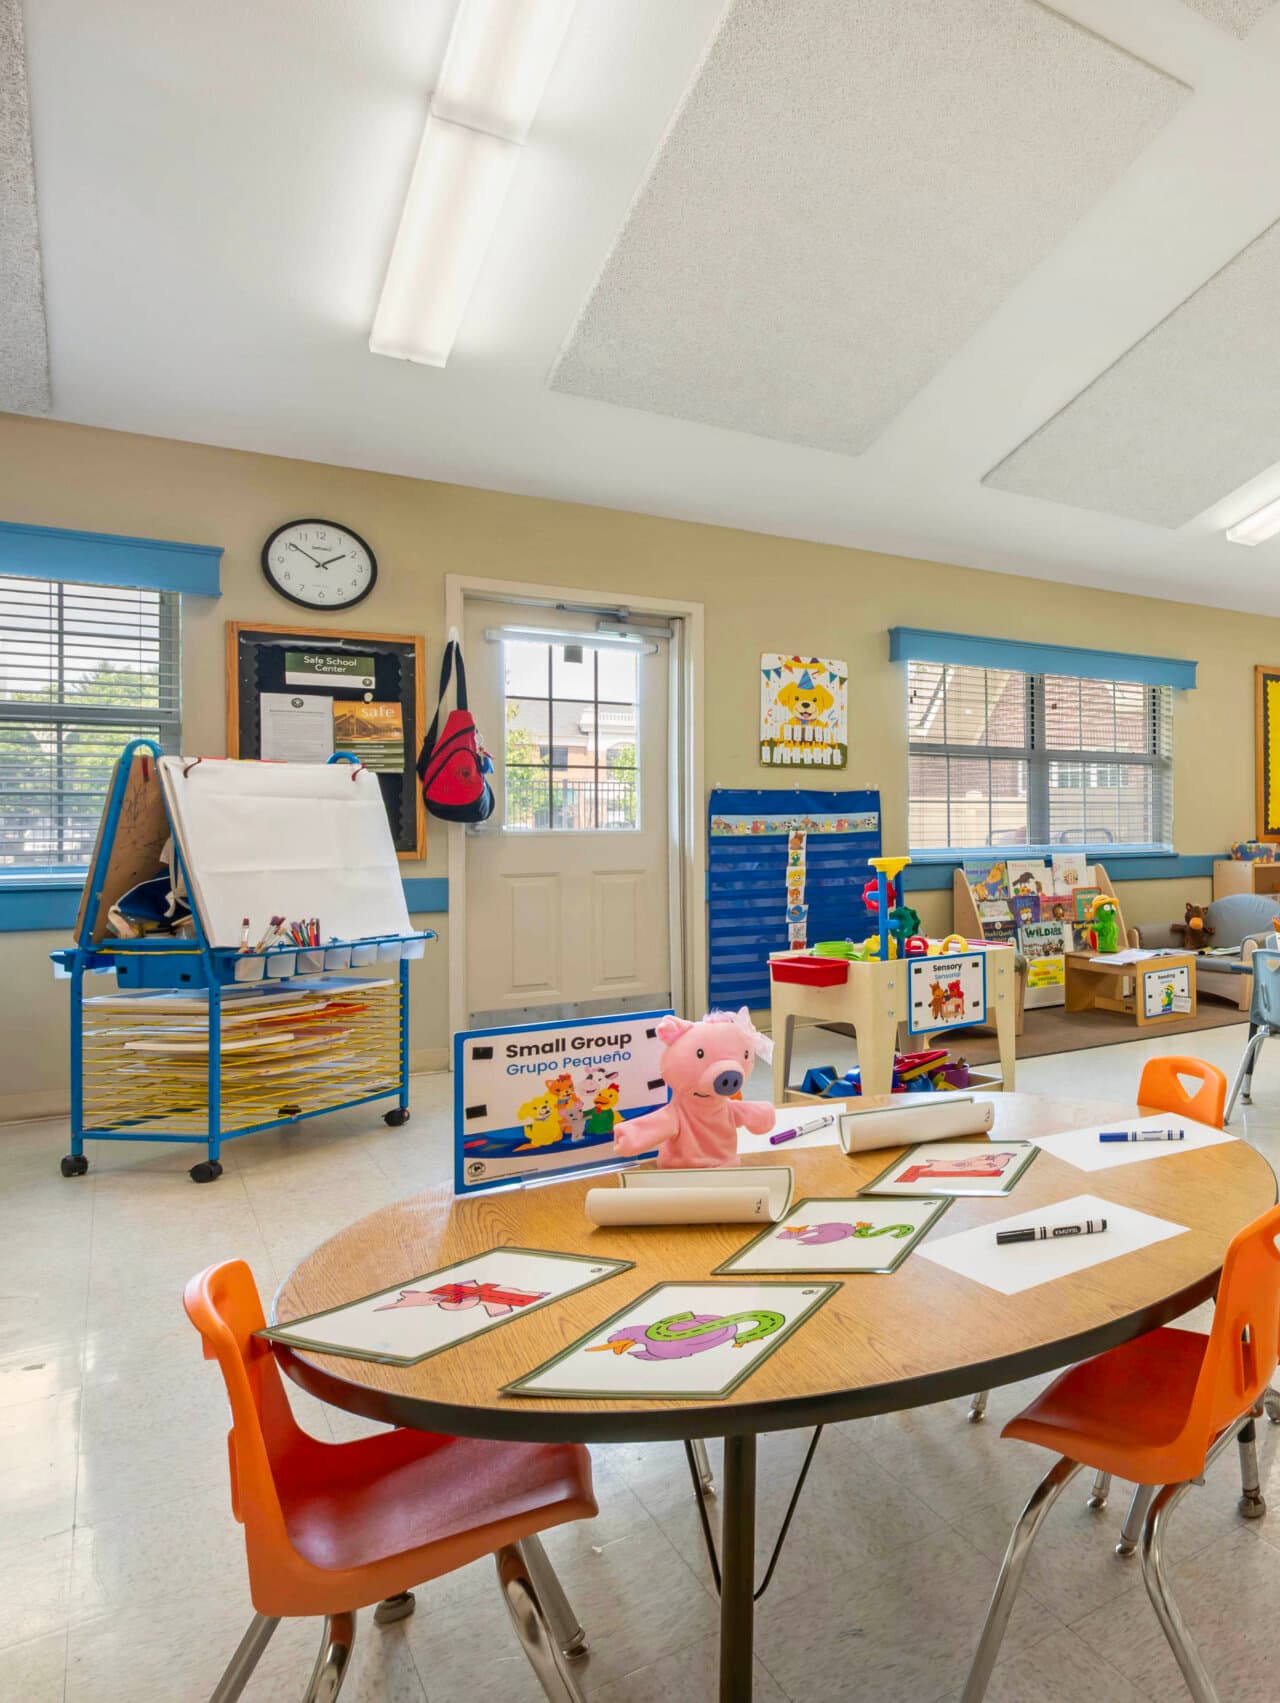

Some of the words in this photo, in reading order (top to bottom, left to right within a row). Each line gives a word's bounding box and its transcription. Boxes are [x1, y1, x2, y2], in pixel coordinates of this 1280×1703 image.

[299, 532, 308, 541] 11
[316, 531, 326, 540] 12
[350, 551, 357, 559] 2
[277, 556, 285, 564] 9
[356, 564, 363, 573] 3
[284, 572, 290, 580] 8
[351, 579, 357, 587] 4
[337, 588, 343, 596] 5
[303, 655, 324, 665] Safe
[326, 657, 357, 666] School
[315, 664, 346, 673] Center
[360, 705, 395, 718] safe
[1025, 928, 1051, 938] WILD
[933, 963, 962, 972] Sensory
[506, 1038, 566, 1059] Small
[571, 1033, 632, 1050] Group
[506, 1061, 558, 1076] Grupo
[563, 1051, 632, 1068] Pequeño
